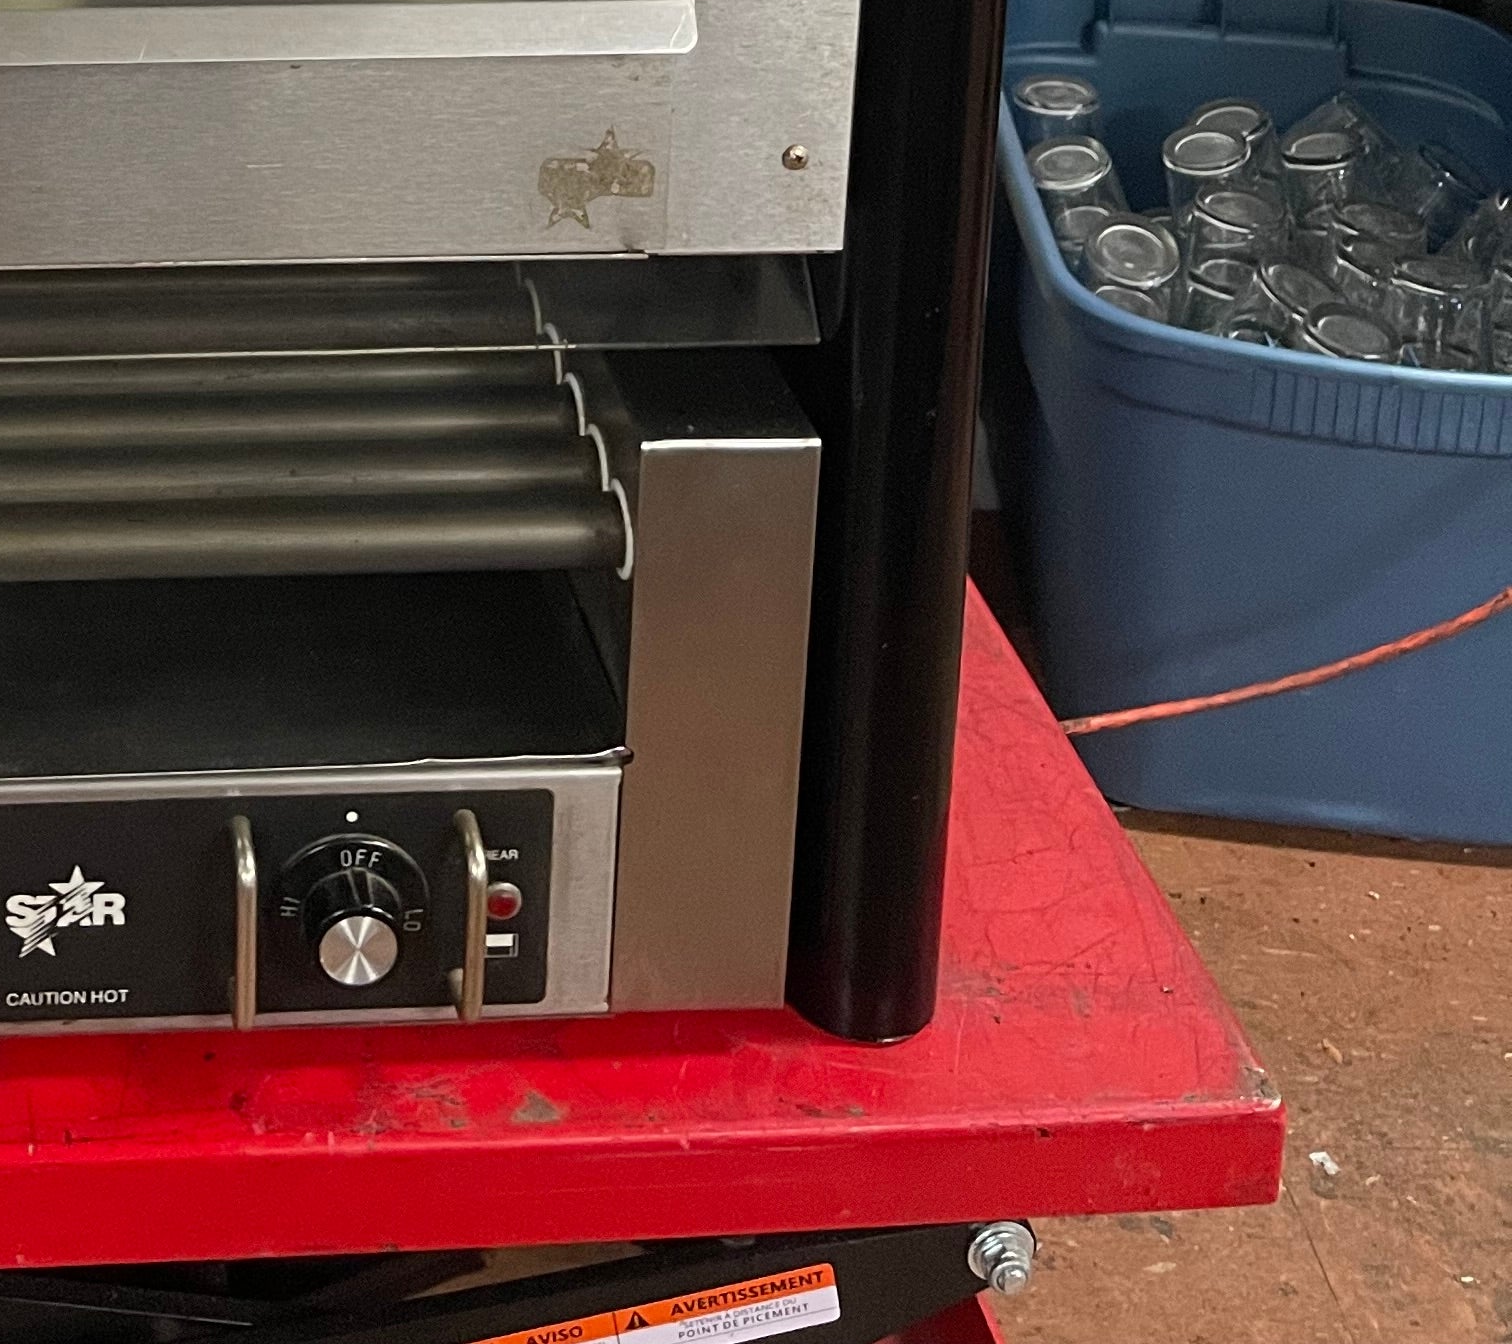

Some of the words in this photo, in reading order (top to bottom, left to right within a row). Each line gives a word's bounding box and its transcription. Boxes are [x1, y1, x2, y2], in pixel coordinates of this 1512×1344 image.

[340, 848, 383, 869] OFF
[5, 892, 127, 928] STAR
[5, 990, 87, 1007] CAUTION
[90, 989, 129, 1004] HOT
[670, 1270, 824, 1317] AVERTISSEMENT
[678, 1323, 719, 1339] POINT
[722, 1320, 739, 1330] DE
[743, 1302, 809, 1326] PICEMENT
